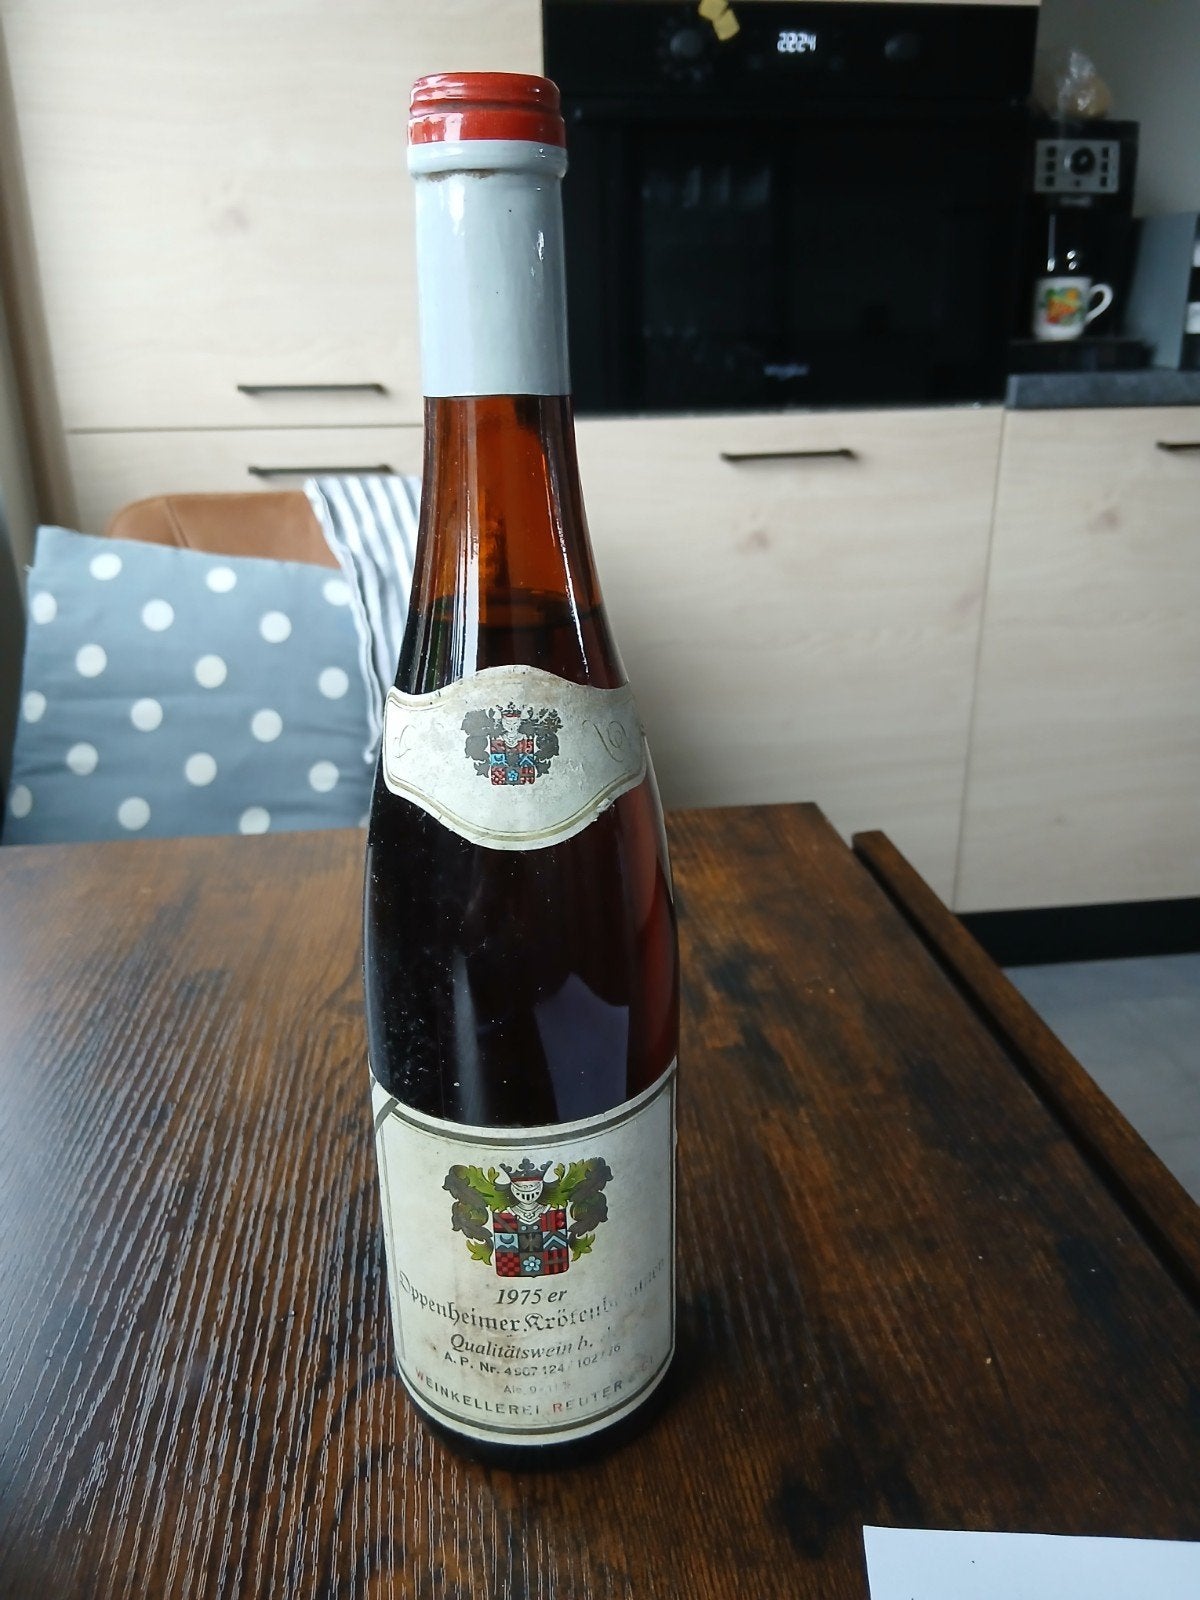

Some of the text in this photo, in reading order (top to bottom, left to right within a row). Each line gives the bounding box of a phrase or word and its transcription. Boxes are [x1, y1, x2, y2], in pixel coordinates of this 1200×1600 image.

[400, 1271, 520, 1332] Oppenheimer
[496, 1288, 568, 1305] 1975 er
[450, 1333, 572, 1360] Qualitätswein
[415, 1366, 540, 1415] WEINKELLEREI
